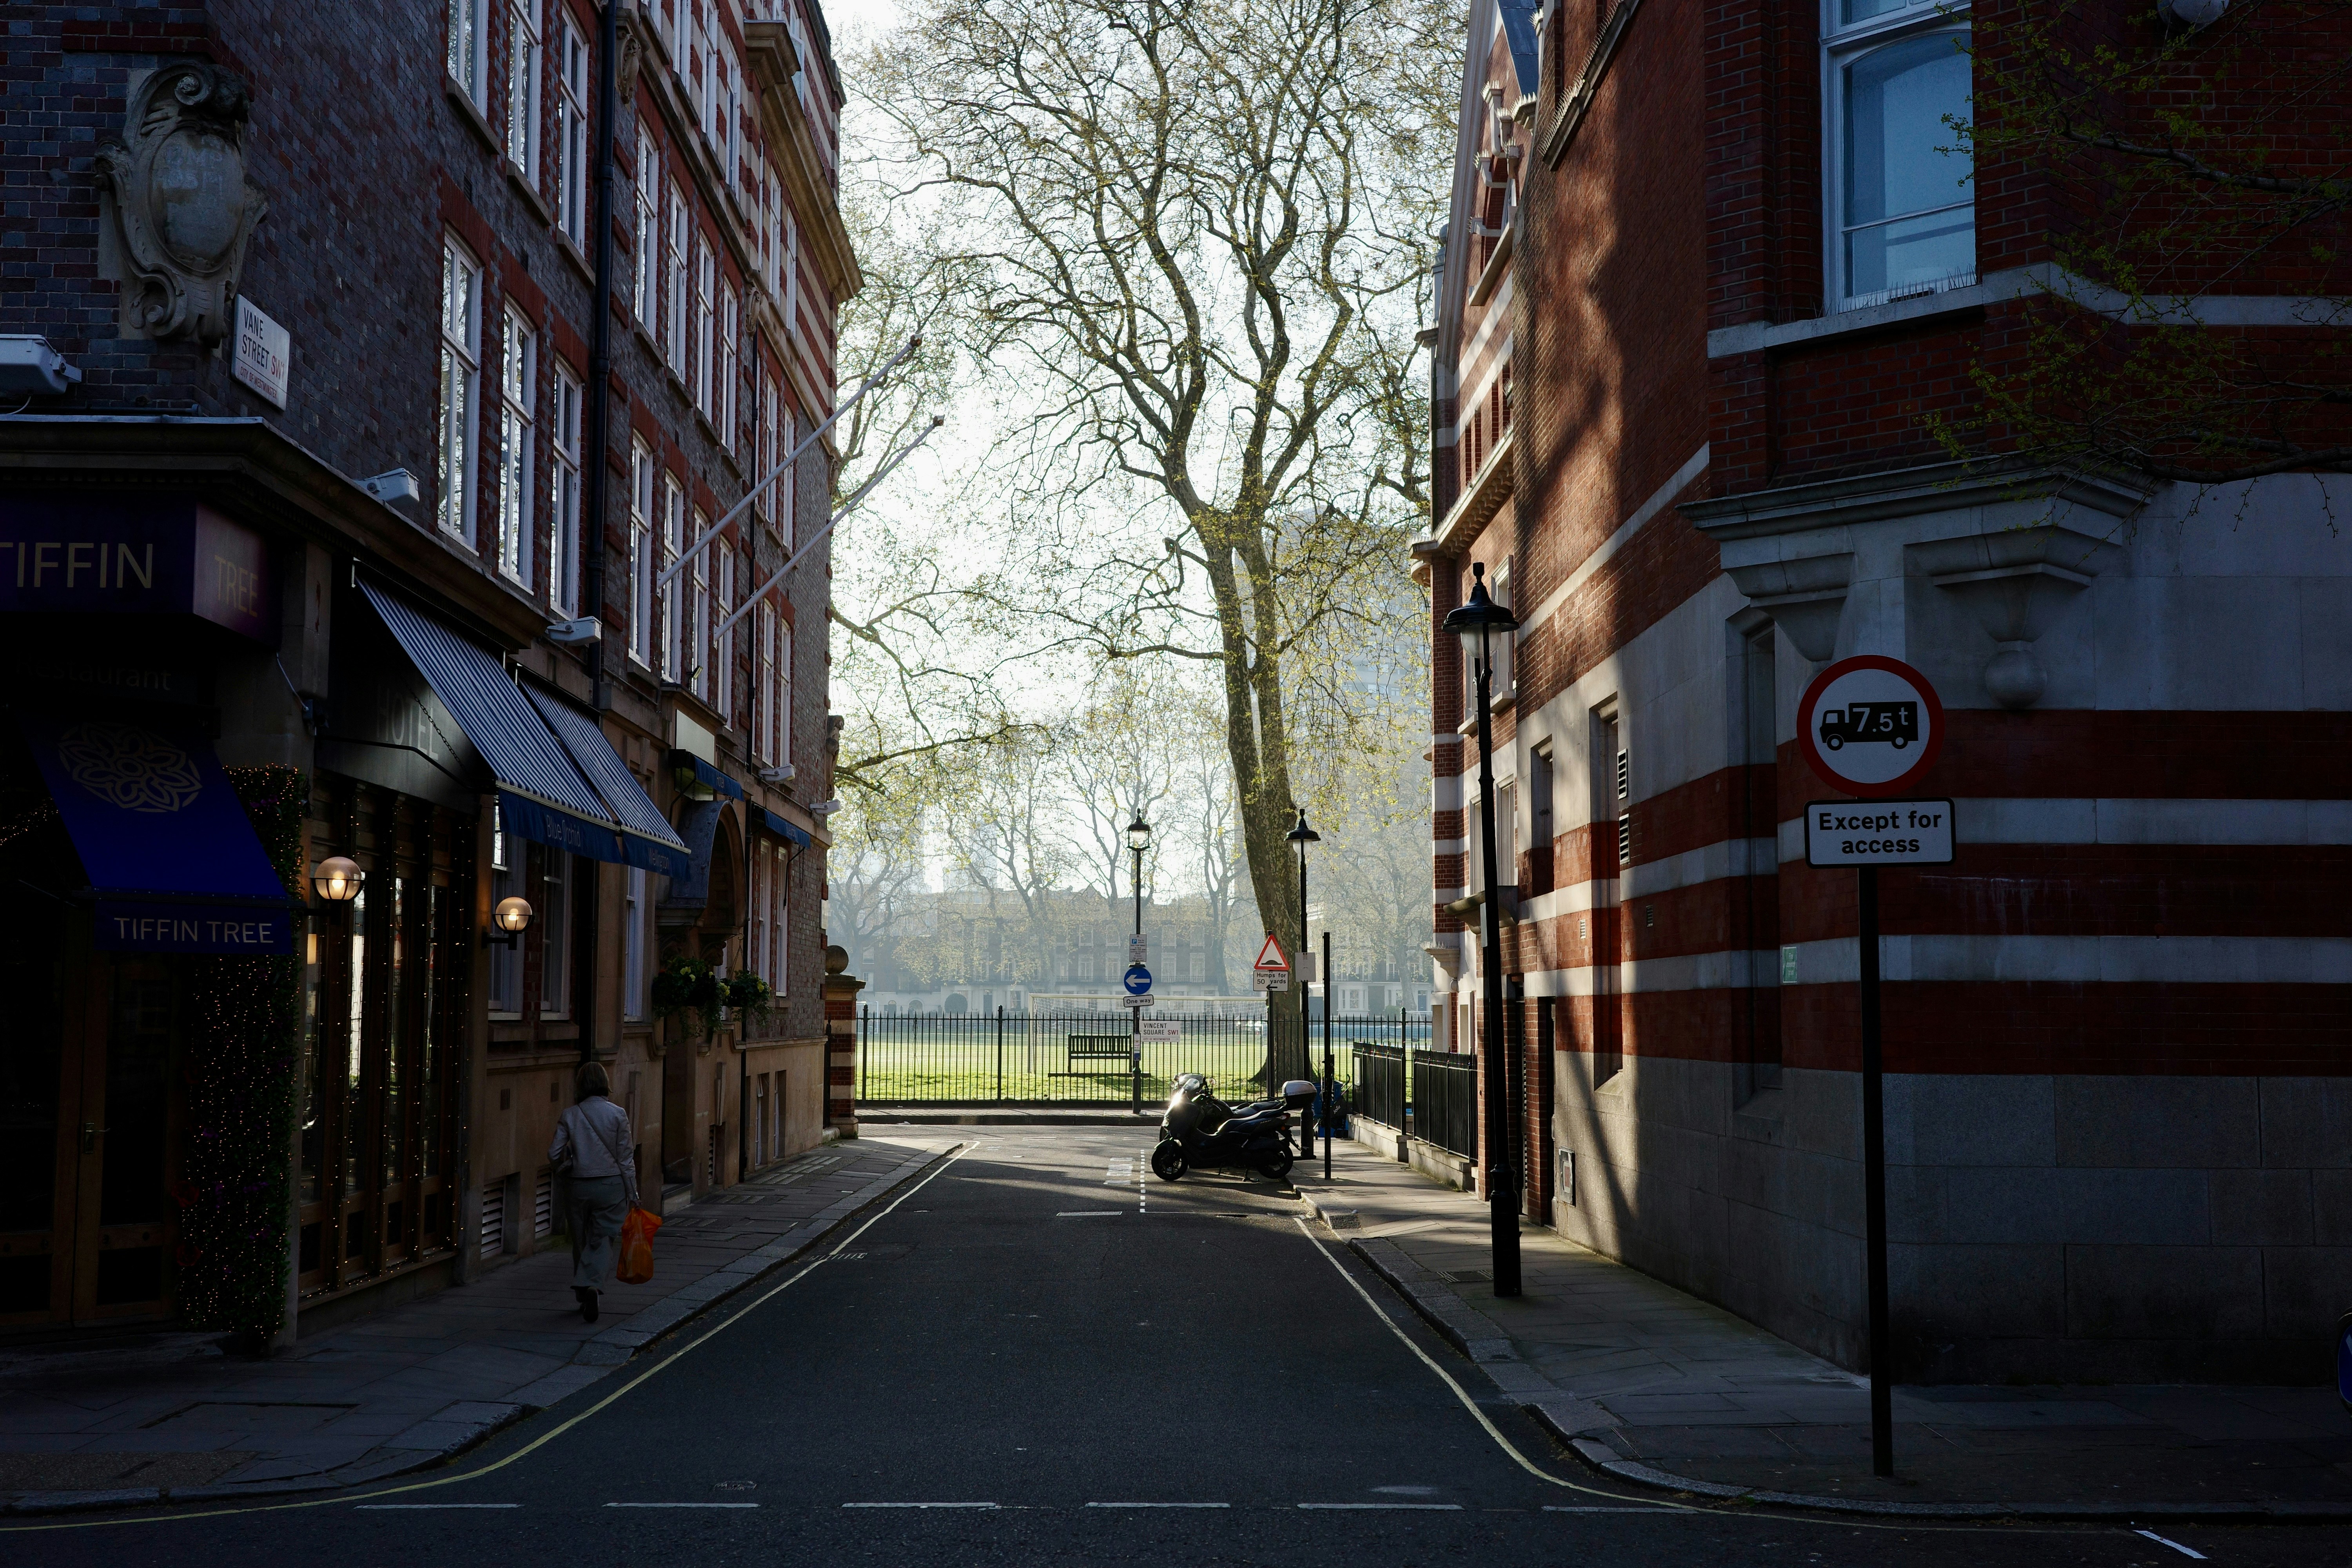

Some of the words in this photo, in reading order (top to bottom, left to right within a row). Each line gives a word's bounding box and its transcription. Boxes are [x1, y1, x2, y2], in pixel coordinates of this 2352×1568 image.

[244, 307, 263, 340] VANE
[242, 334, 269, 370] STREET
[271, 355, 284, 382] SW1
[249, 372, 254, 382] OF
[254, 375, 277, 398] WESTMINSTER
[215, 554, 259, 617] TREE
[376, 684, 438, 760] HOTEL
[546, 814, 562, 841] Blue
[1819, 811, 1899, 833] Except
[1908, 811, 1942, 828] for
[1842, 839, 1920, 854] access
[114, 917, 198, 941] TIFFIN
[206, 921, 274, 944] TREE
